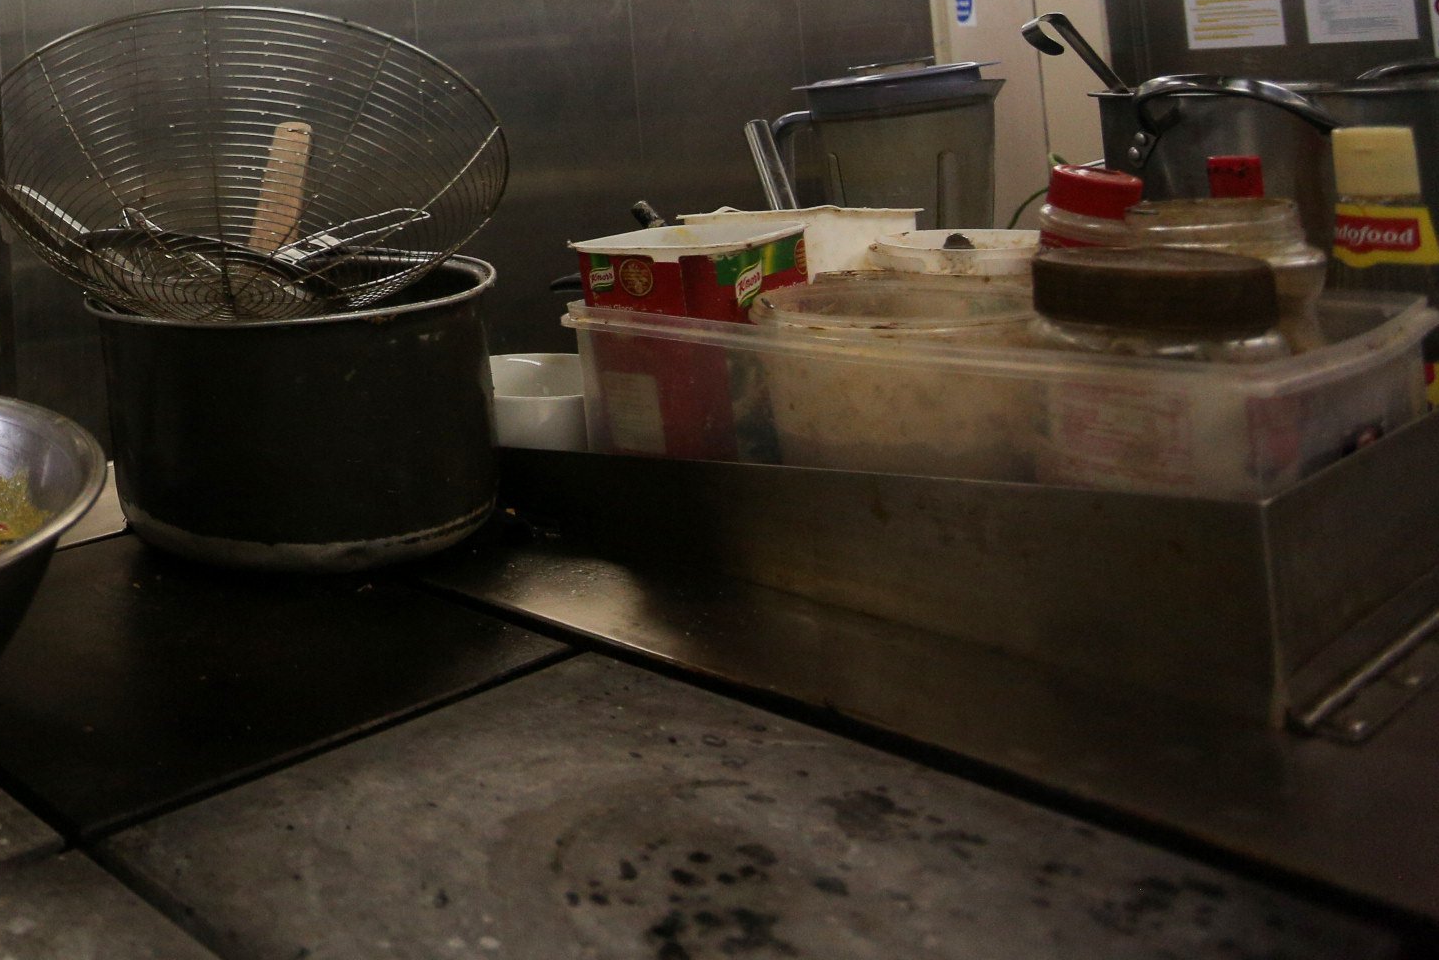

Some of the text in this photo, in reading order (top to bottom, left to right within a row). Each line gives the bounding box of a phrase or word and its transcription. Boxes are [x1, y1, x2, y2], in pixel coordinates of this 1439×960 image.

[1335, 224, 1414, 246] dofood
[590, 271, 613, 283] Knorr
[737, 270, 762, 295] Knorr
